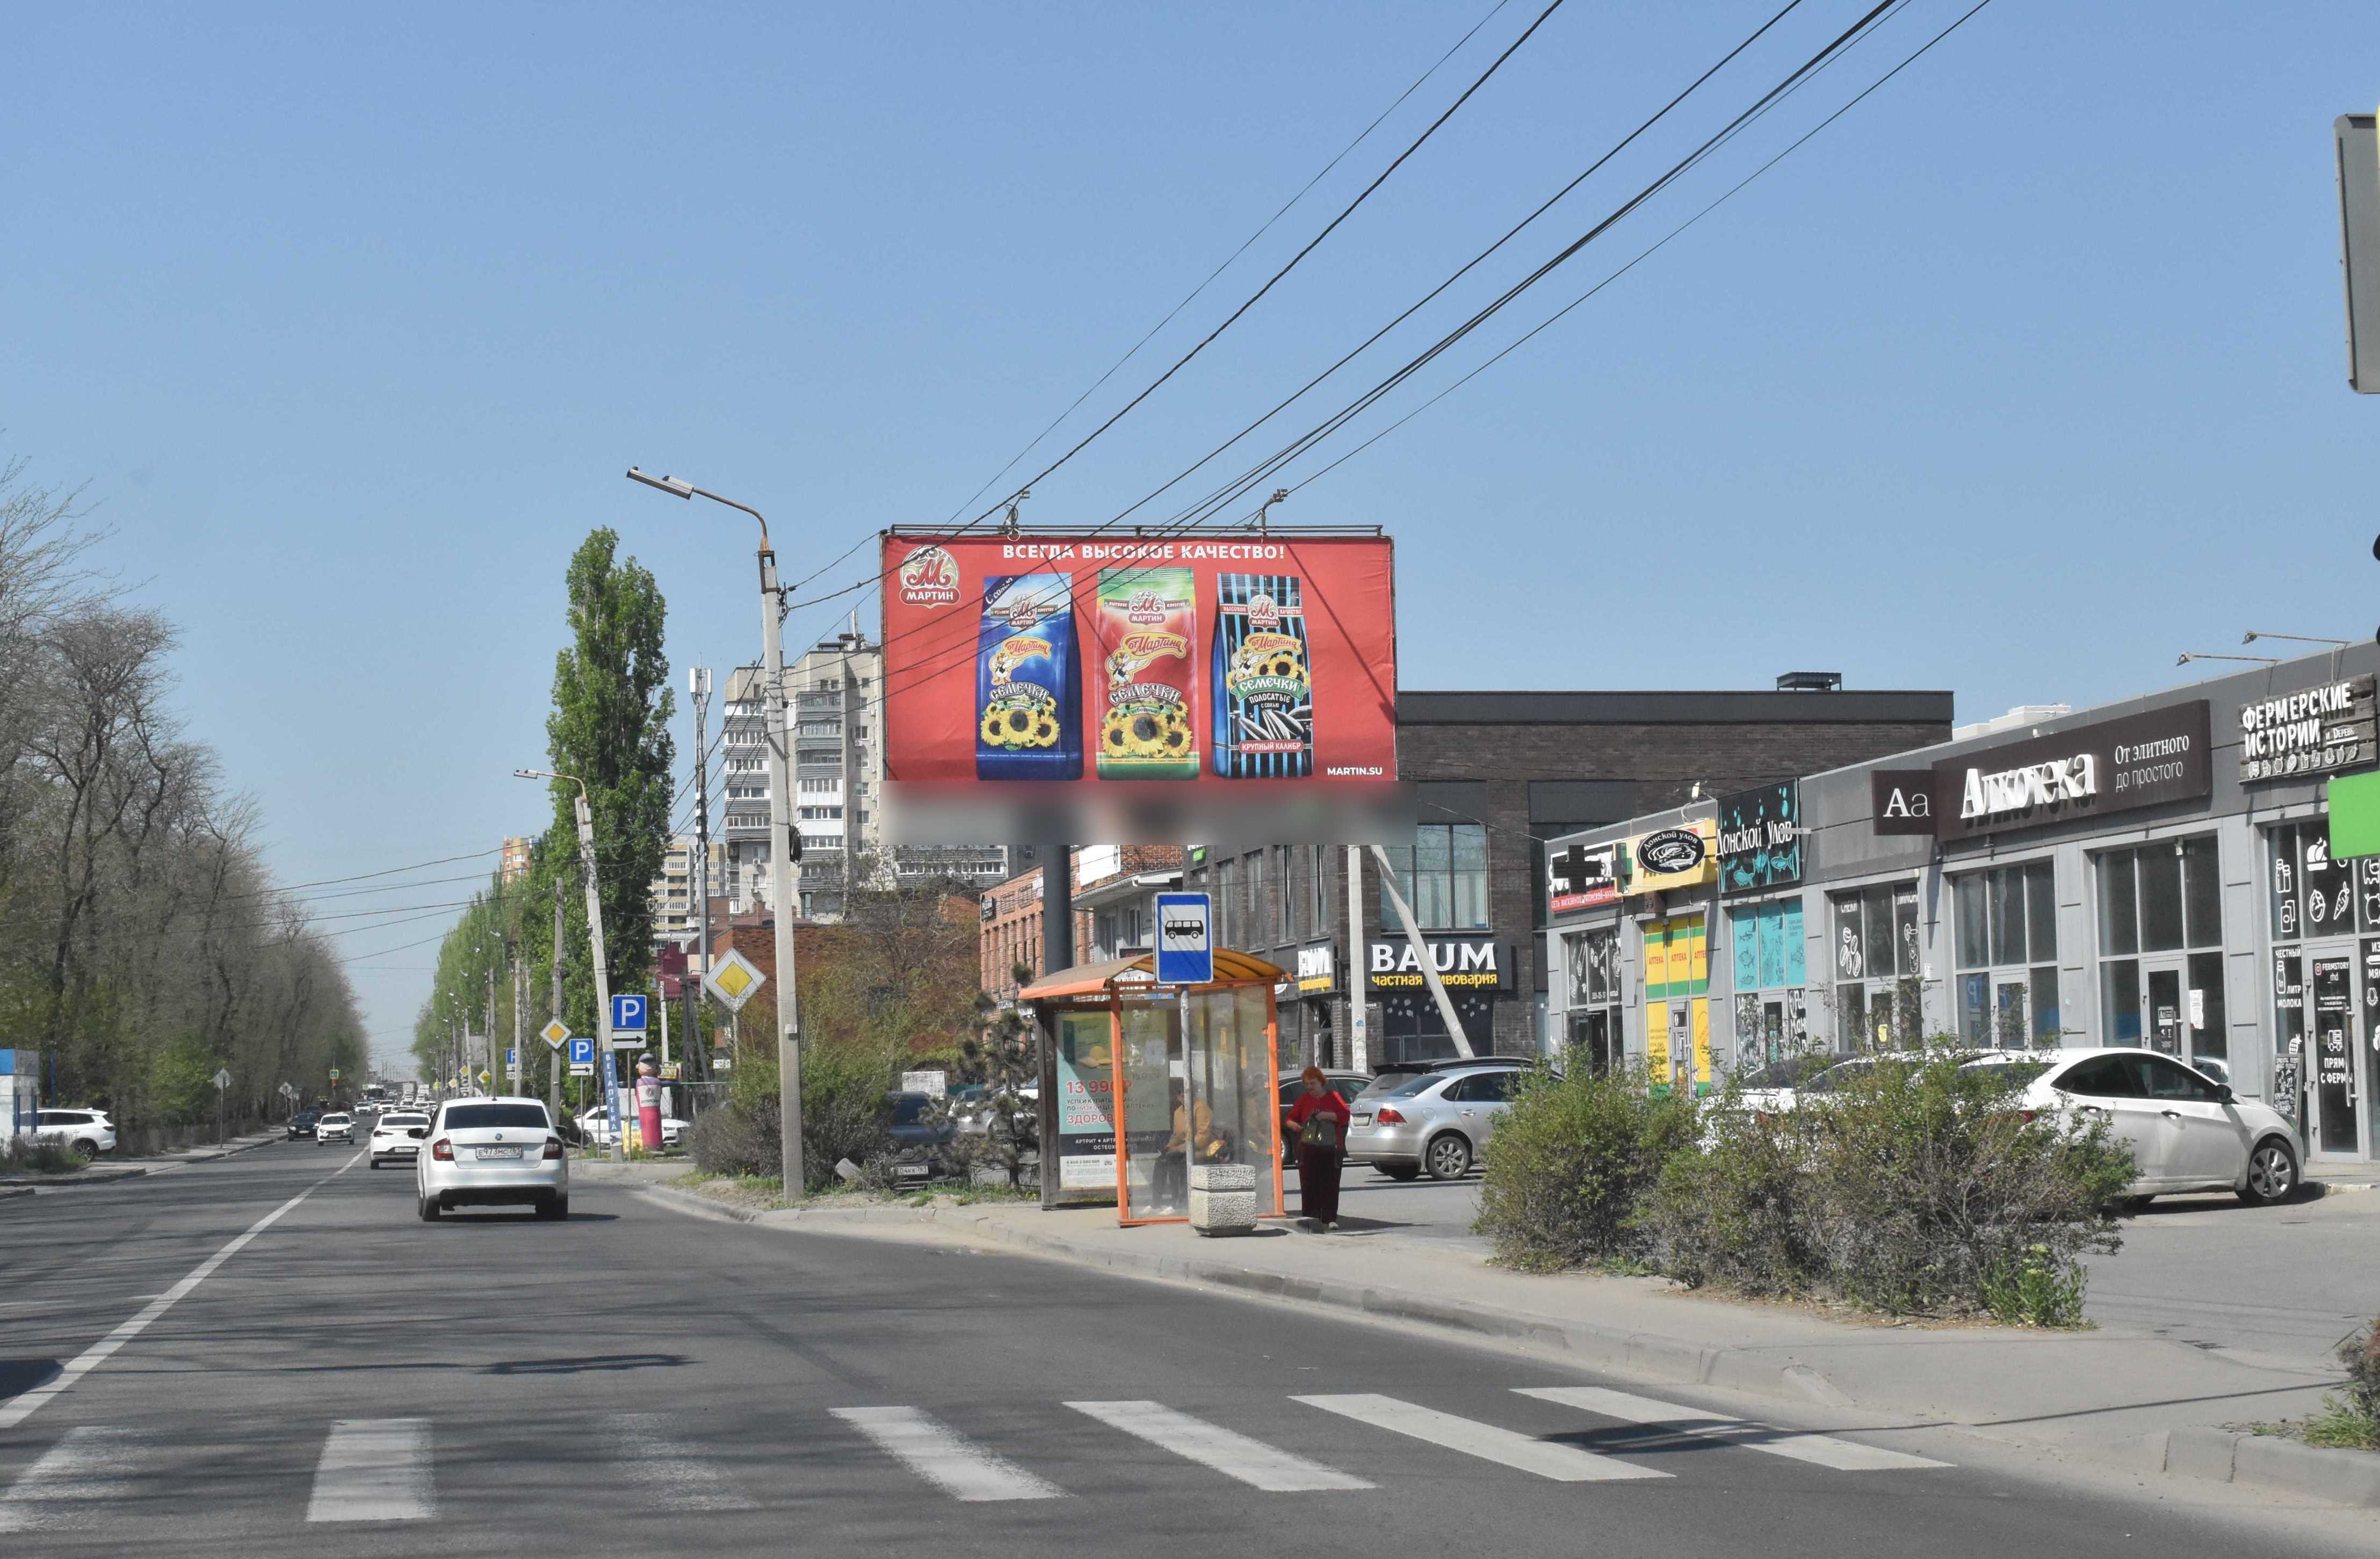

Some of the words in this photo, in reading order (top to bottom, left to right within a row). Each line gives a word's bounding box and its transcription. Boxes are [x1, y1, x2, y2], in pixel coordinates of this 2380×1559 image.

[1003, 545, 1075, 560] ВСЕГДА
[1082, 545, 1174, 560] ВЫСОКОЕ
[1182, 545, 1285, 559] КАЧЕСТВО!
[906, 591, 954, 601] МАРТИН
[1014, 640, 1048, 654] Мартина
[1135, 636, 1182, 654] Мартина
[1258, 636, 1299, 652] Мартина
[990, 682, 1049, 702] СЕМЕЧКИ
[1239, 676, 1298, 693] СЕМЕЧКИ
[1109, 683, 1181, 705] СЕМЕЧКИ
[1248, 692, 1291, 704] ПОЛОСАТЫЕ
[2242, 682, 2353, 732] ФЕРМЕРСКИЕ
[2244, 718, 2320, 757] ИСТОРИИ
[1242, 741, 1275, 751] КРУПНЫЙ
[1275, 742, 1301, 750] КАЛИБР
[2115, 745, 2130, 765] От
[2132, 735, 2189, 760] элитного
[1327, 767, 1383, 775] MARTIN.SU
[2116, 771, 2129, 792] до
[2132, 761, 2183, 789] простого
[1960, 754, 2097, 819] Алкотека
[1883, 788, 1930, 818] Аа
[1643, 830, 1677, 852] Донской
[1679, 832, 1699, 845] улов
[1716, 818, 1762, 861] Донской
[1767, 820, 1793, 850] Улов
[1371, 943, 1498, 972] BAUM
[1648, 955, 1665, 965] АПТЕКА
[1670, 951, 1687, 963] АПТЕКА
[2275, 946, 2302, 958] ЧЕСТНЫЙ
[1371, 975, 1423, 987] частная
[1439, 973, 1498, 988] ивоварня
[2286, 985, 2302, 994] ЛИТР
[2277, 998, 2303, 1008] МОЛОКА
[621, 999, 640, 1025] P
[576, 1042, 589, 1059] P
[2324, 1057, 2347, 1069] ПРЯМ
[2320, 1072, 2326, 1084] С
[1067, 1080, 1084, 1094] 13
